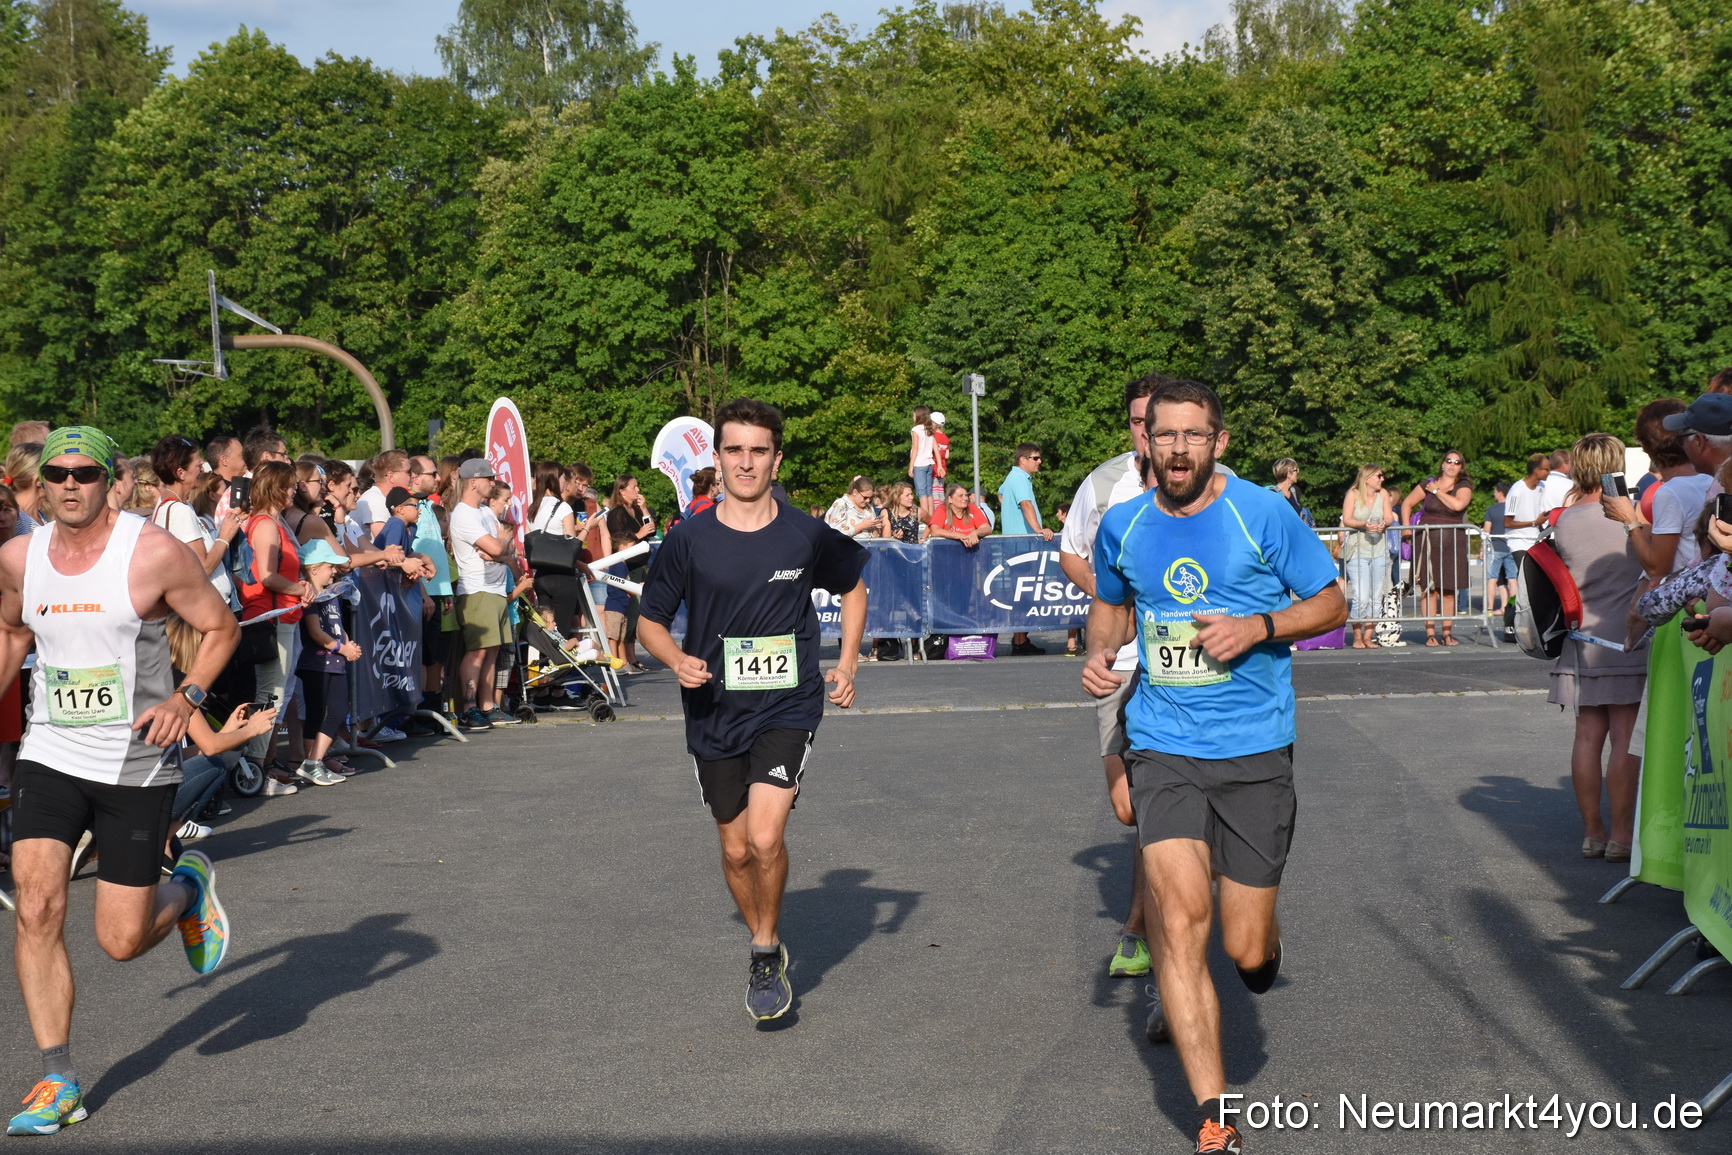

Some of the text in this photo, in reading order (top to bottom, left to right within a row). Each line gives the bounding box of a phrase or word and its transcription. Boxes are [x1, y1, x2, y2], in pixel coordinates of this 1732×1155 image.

[1014, 576, 1093, 602] Fisc
[51, 603, 106, 613] KLEBL
[1026, 604, 1090, 617] AUTOM
[375, 630, 417, 668] Fisher
[1159, 645, 1204, 668] 977
[734, 655, 788, 675] 1412
[54, 686, 113, 709] 1176
[768, 771, 789, 782] adidas
